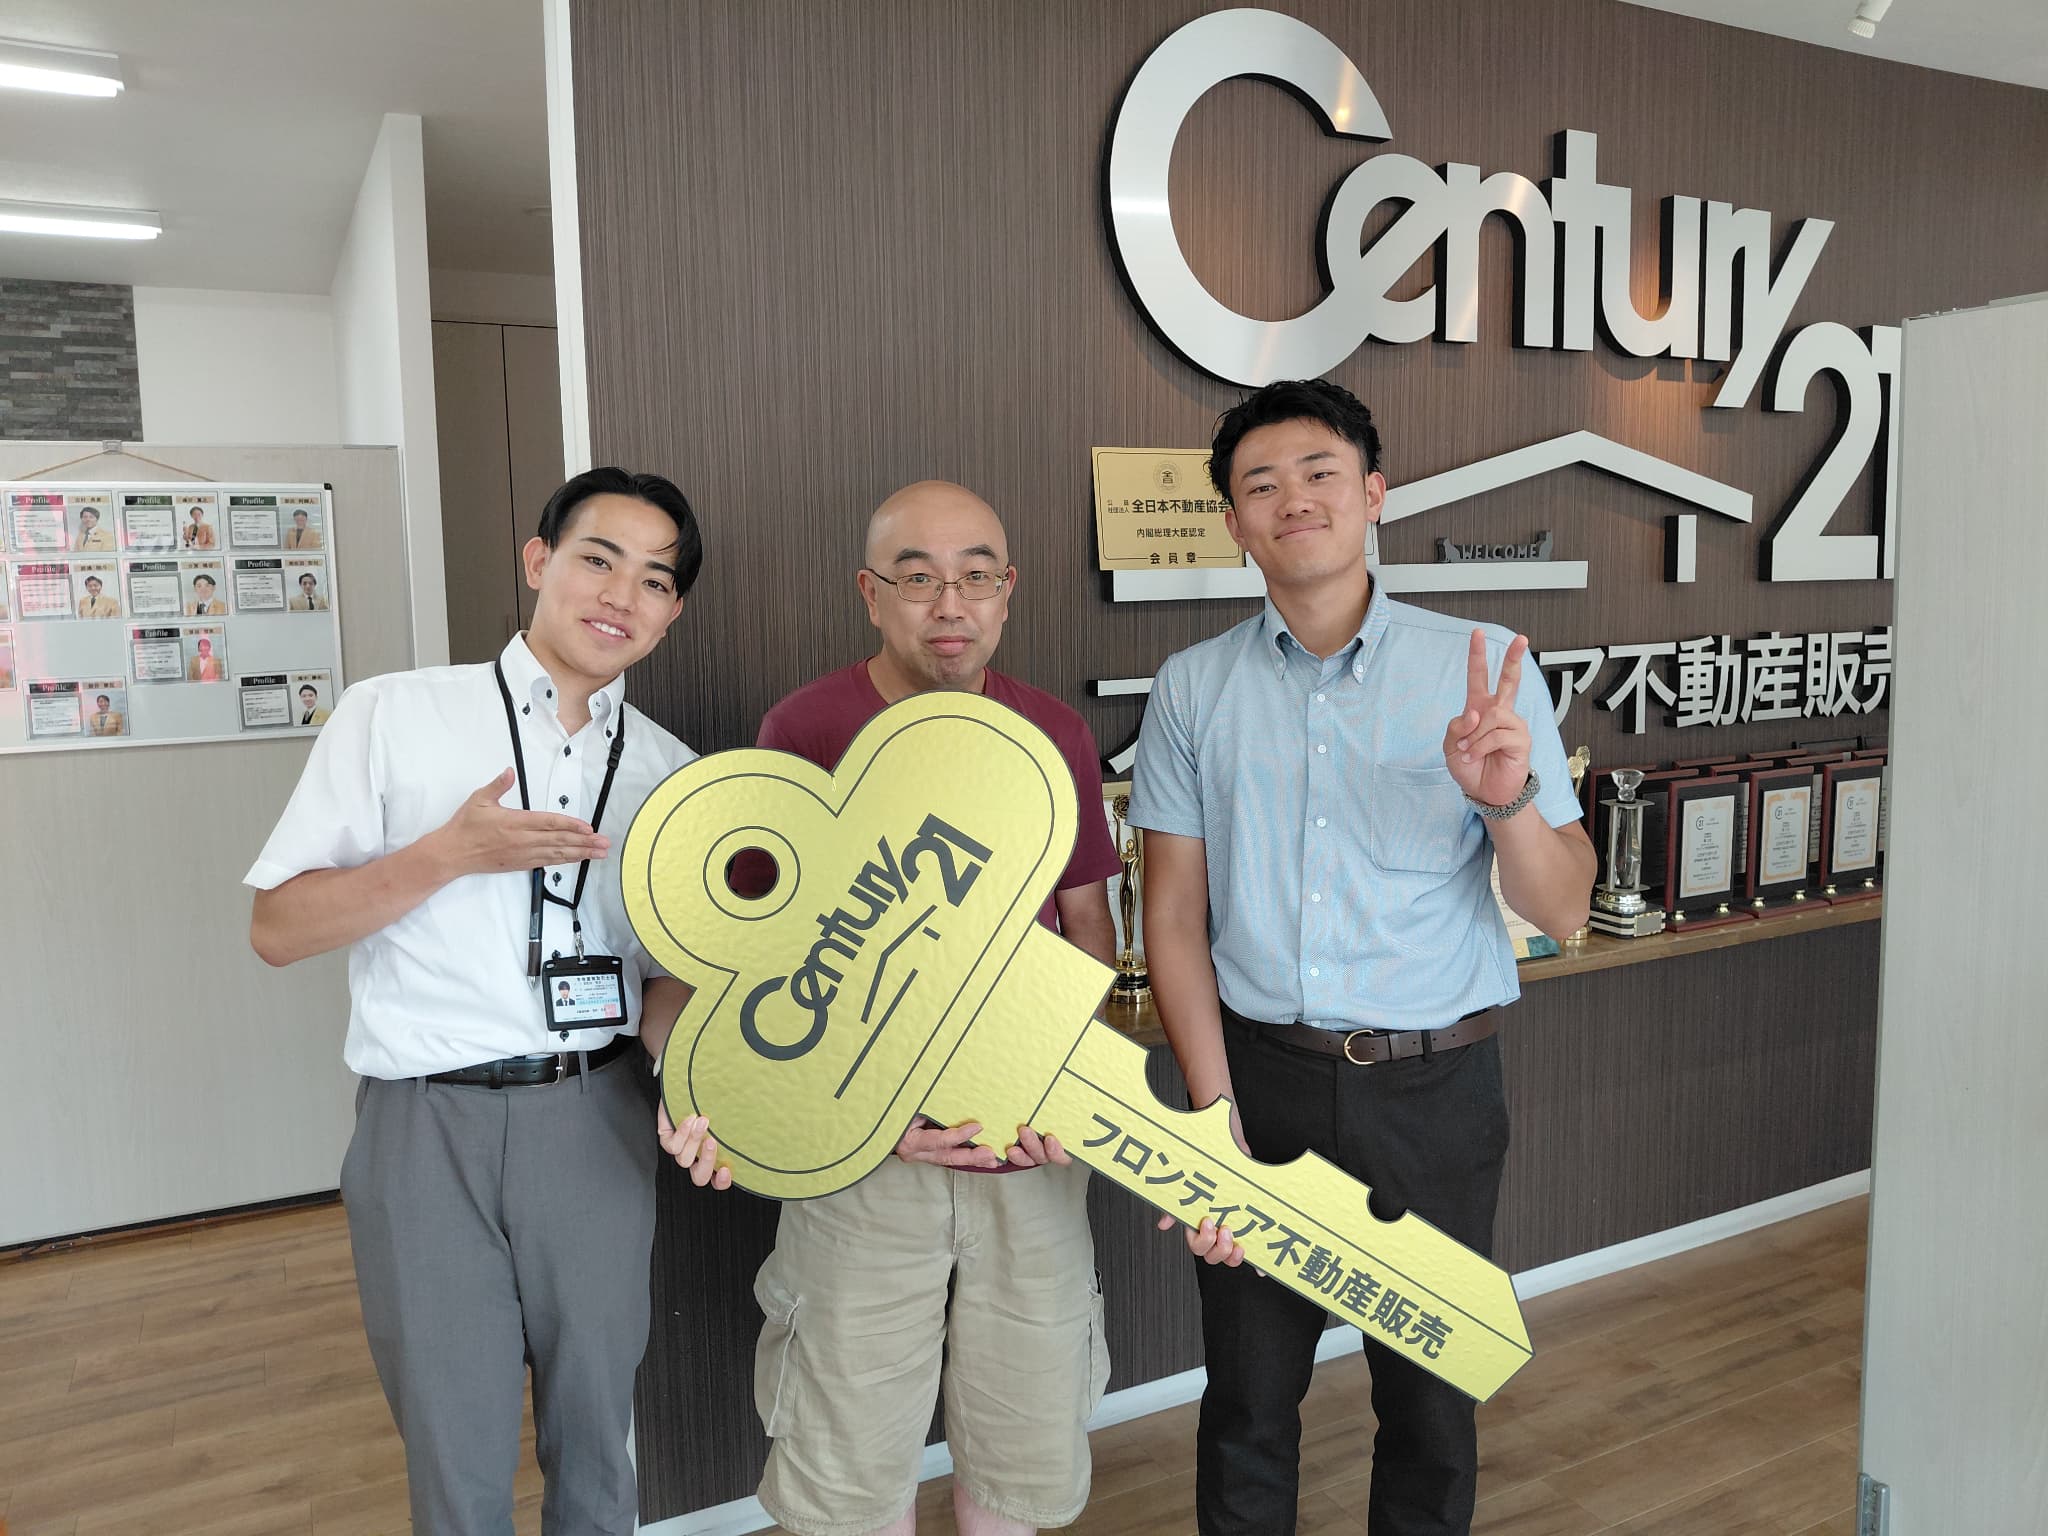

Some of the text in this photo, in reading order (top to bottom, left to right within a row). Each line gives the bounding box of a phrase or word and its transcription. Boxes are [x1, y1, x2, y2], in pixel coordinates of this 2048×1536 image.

[1108, 7, 1835, 408] Century
[1462, 543, 1539, 560] WELCOME
[142, 563, 166, 571] Profile
[247, 560, 271, 568] Profile
[253, 677, 276, 685] Profile
[739, 813, 994, 1061] Century 21
[1082, 1113, 1454, 1360] フロンティア不動産販売
